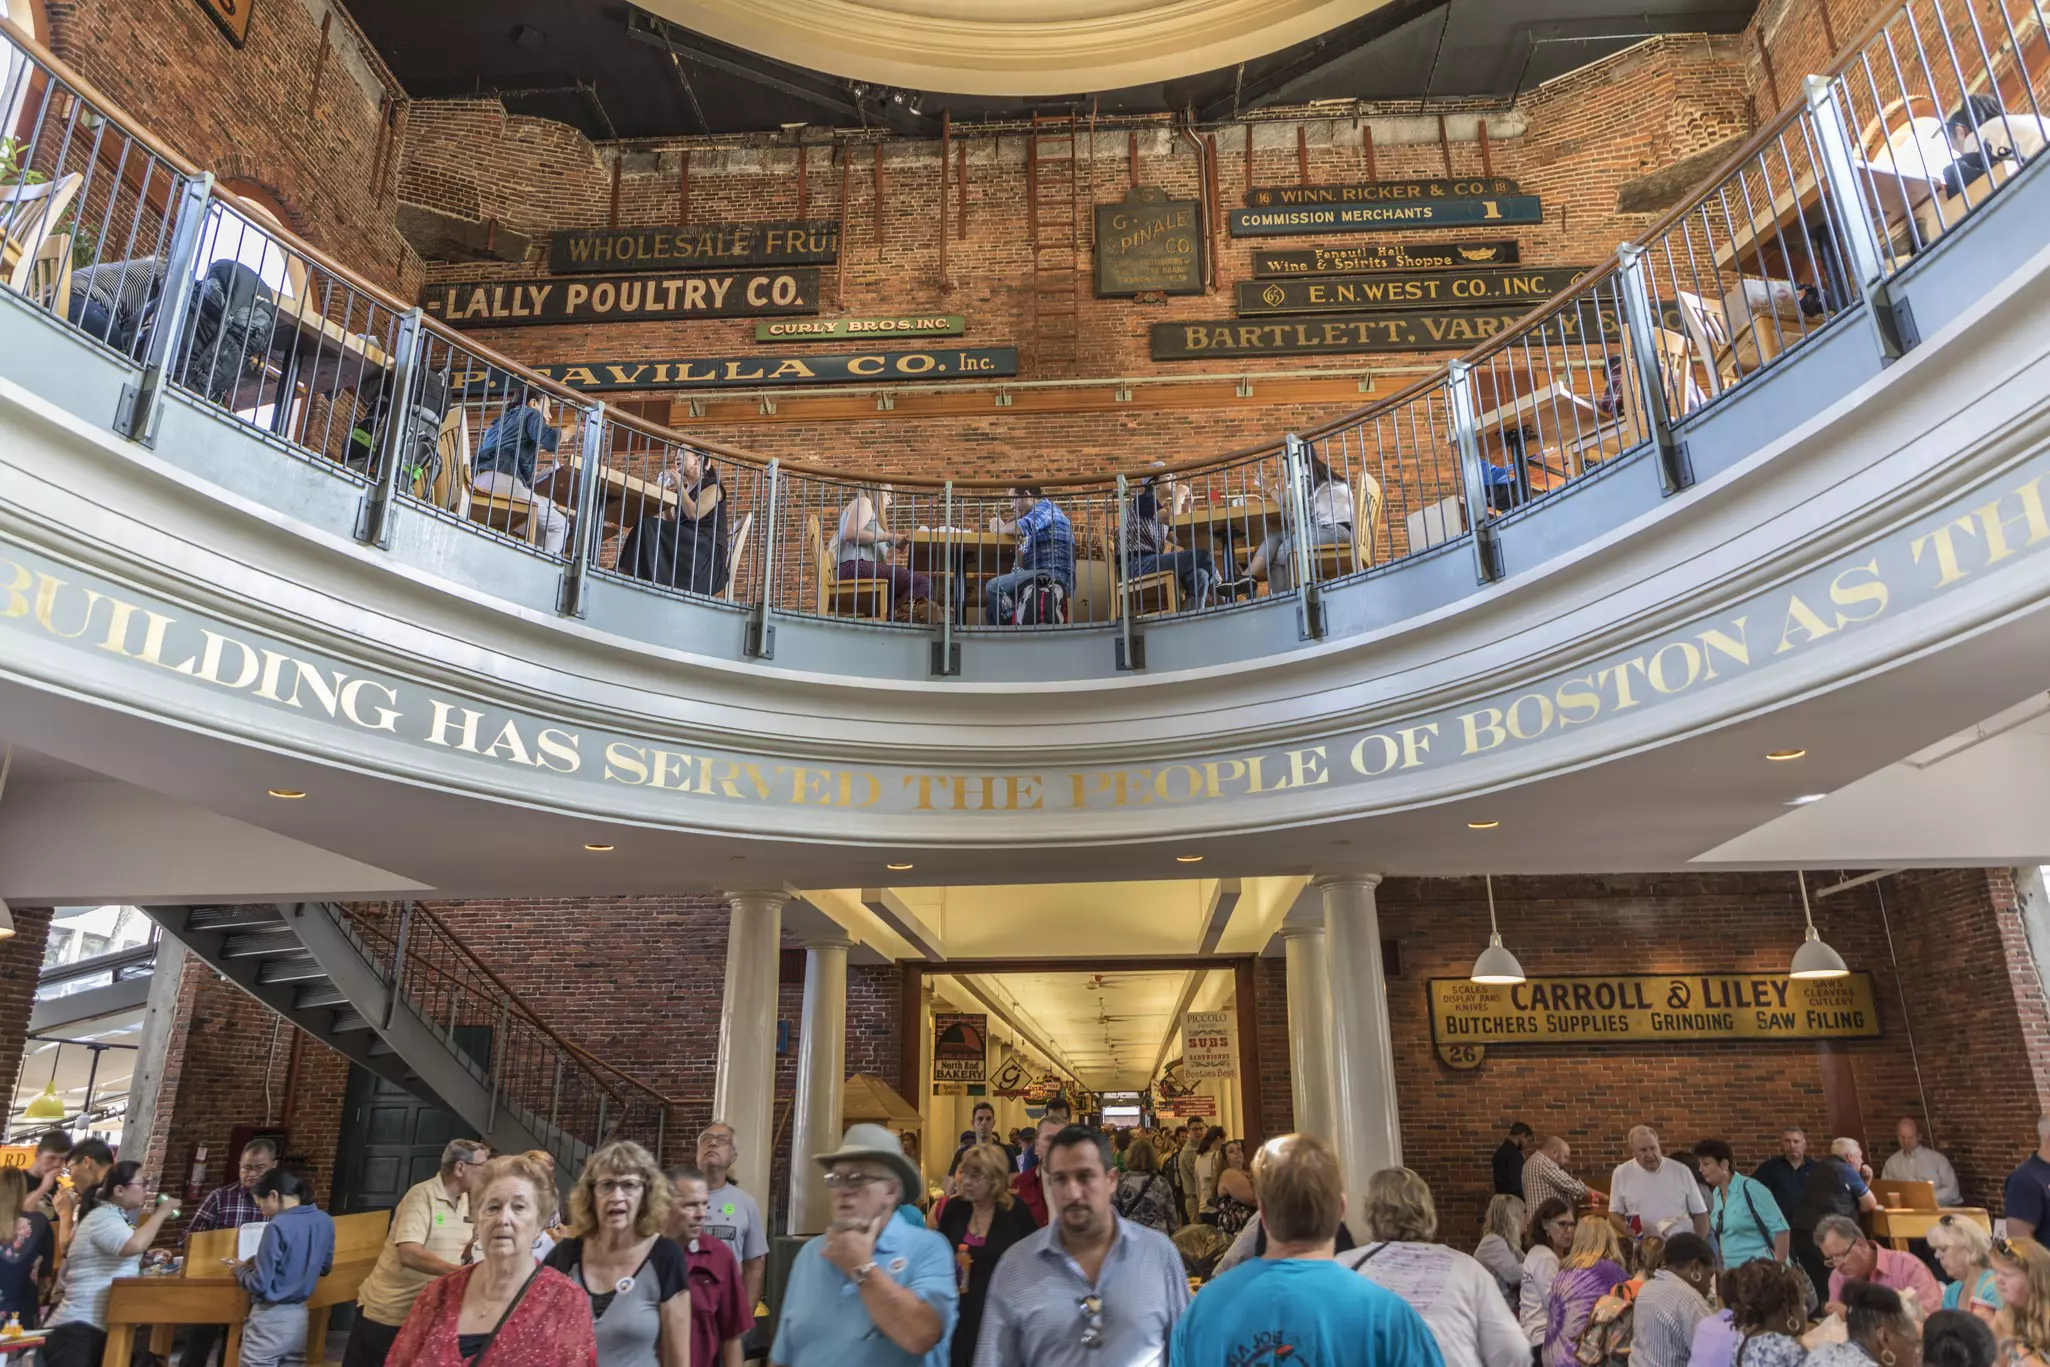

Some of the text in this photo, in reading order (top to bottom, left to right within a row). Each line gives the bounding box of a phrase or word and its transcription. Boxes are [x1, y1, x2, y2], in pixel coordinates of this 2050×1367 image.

[1141, 189, 1154, 202] 5
[1257, 193, 1270, 203] 16
[1343, 187, 1421, 200] RICKER
[1430, 183, 1445, 196] &
[1241, 201, 1503, 226] COMMISSION MERCHANTS 1
[1106, 211, 1189, 257] SPINALE
[569, 231, 749, 262] WHOLESALE
[1166, 238, 1194, 254] CO.
[1315, 246, 1405, 260] Faneuil Hall
[1267, 255, 1453, 273] Wine & Spirits Shoppe
[1504, 276, 1552, 295] INC.
[565, 277, 733, 315] POULTRY
[747, 276, 804, 307] CO.
[1266, 289, 1279, 302] 65
[768, 322, 838, 335] CURLY
[1421, 313, 1578, 341] VARY
[847, 354, 947, 375] CO.
[959, 353, 995, 371] Inc.
[424, 699, 581, 773] HAS
[604, 742, 882, 808] SERVED
[904, 774, 1044, 810] THE
[1071, 746, 1329, 808] PEOPLE
[1350, 723, 1439, 776] OF
[1455, 615, 1752, 756] BOSTON
[1774, 558, 1890, 655] AS
[1452, 985, 1489, 995] SCALES
[1813, 979, 1844, 988] SAWS
[1443, 994, 1475, 1004] DISPLAY
[1511, 978, 1790, 1012] CARROLL & LILEY
[1804, 988, 1855, 998] CLEAVERS
[1455, 1003, 1489, 1012] KNIVES
[1809, 997, 1854, 1007] CUTLERY
[1187, 1013, 1227, 1023] PICCOLO
[1446, 1010, 1864, 1035] BUTCHERS SUPPLIES GRINDING SAW FILING
[1188, 1037, 1229, 1048] SUBS
[1450, 1046, 1477, 1063] 26
[941, 1060, 979, 1070] North End
[937, 1070, 984, 1079] BAKERY
